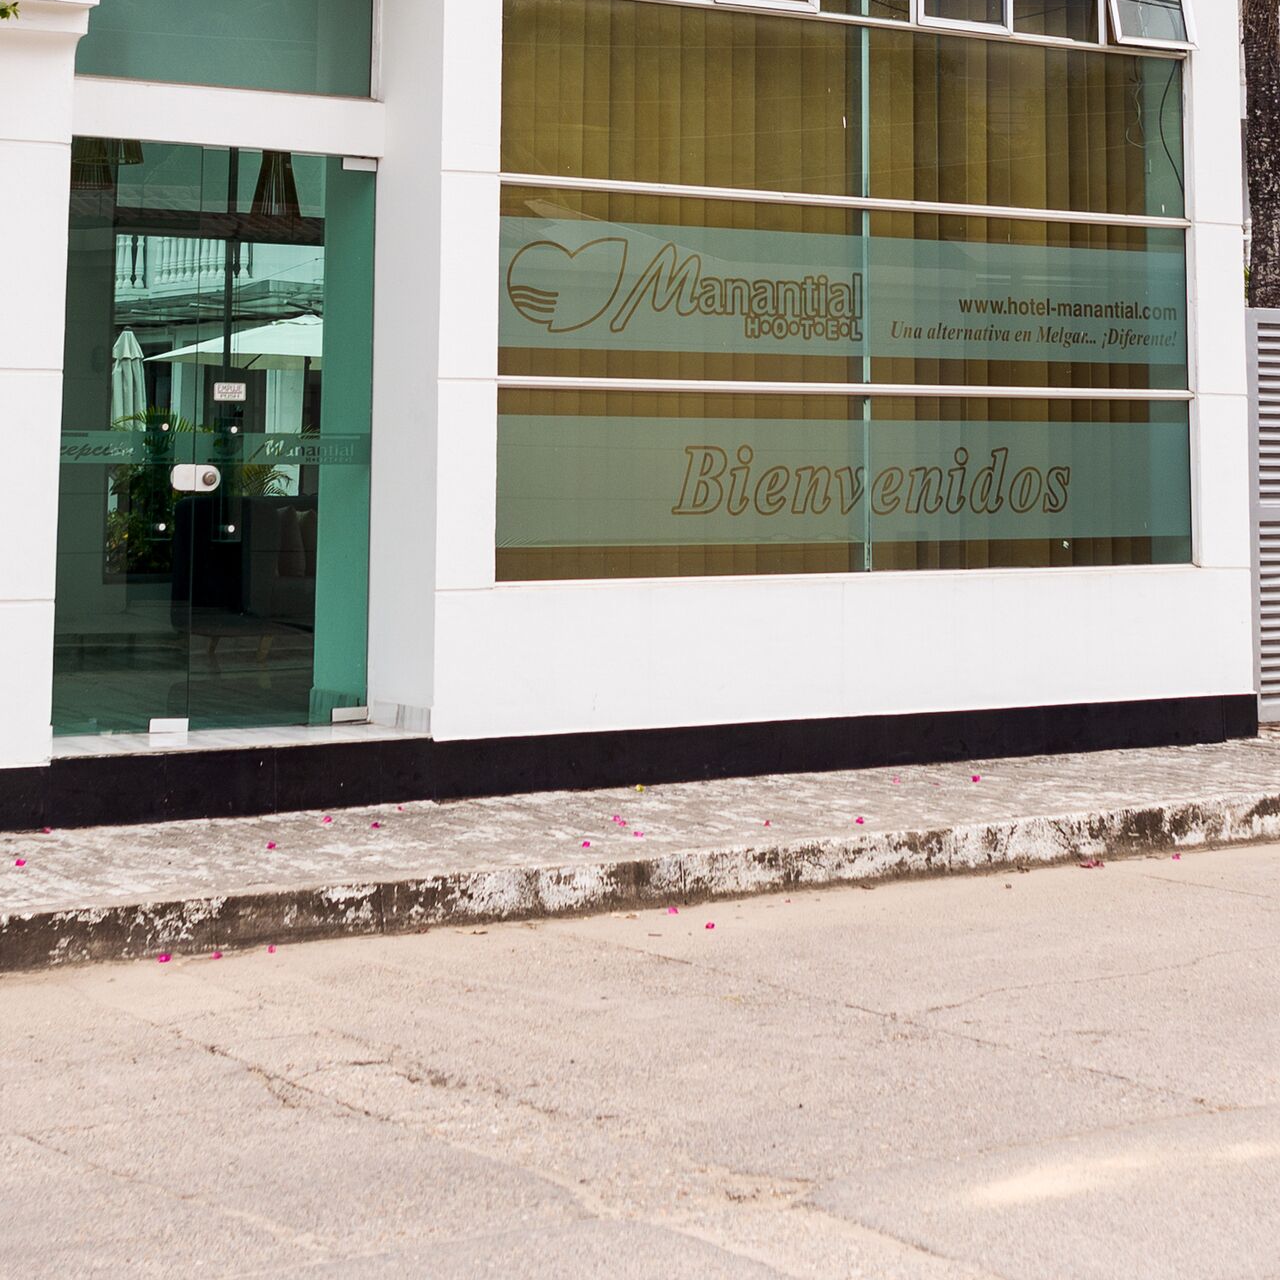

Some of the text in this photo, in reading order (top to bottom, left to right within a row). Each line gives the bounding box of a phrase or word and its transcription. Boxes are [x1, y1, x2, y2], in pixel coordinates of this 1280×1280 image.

[610, 241, 864, 332] Manantial
[958, 296, 1178, 320] www.hotel-manantial.com
[890, 321, 1178, 350] Una alternativa en Melgar... ¡Diferente!
[671, 444, 1071, 516] Bienvenidos
